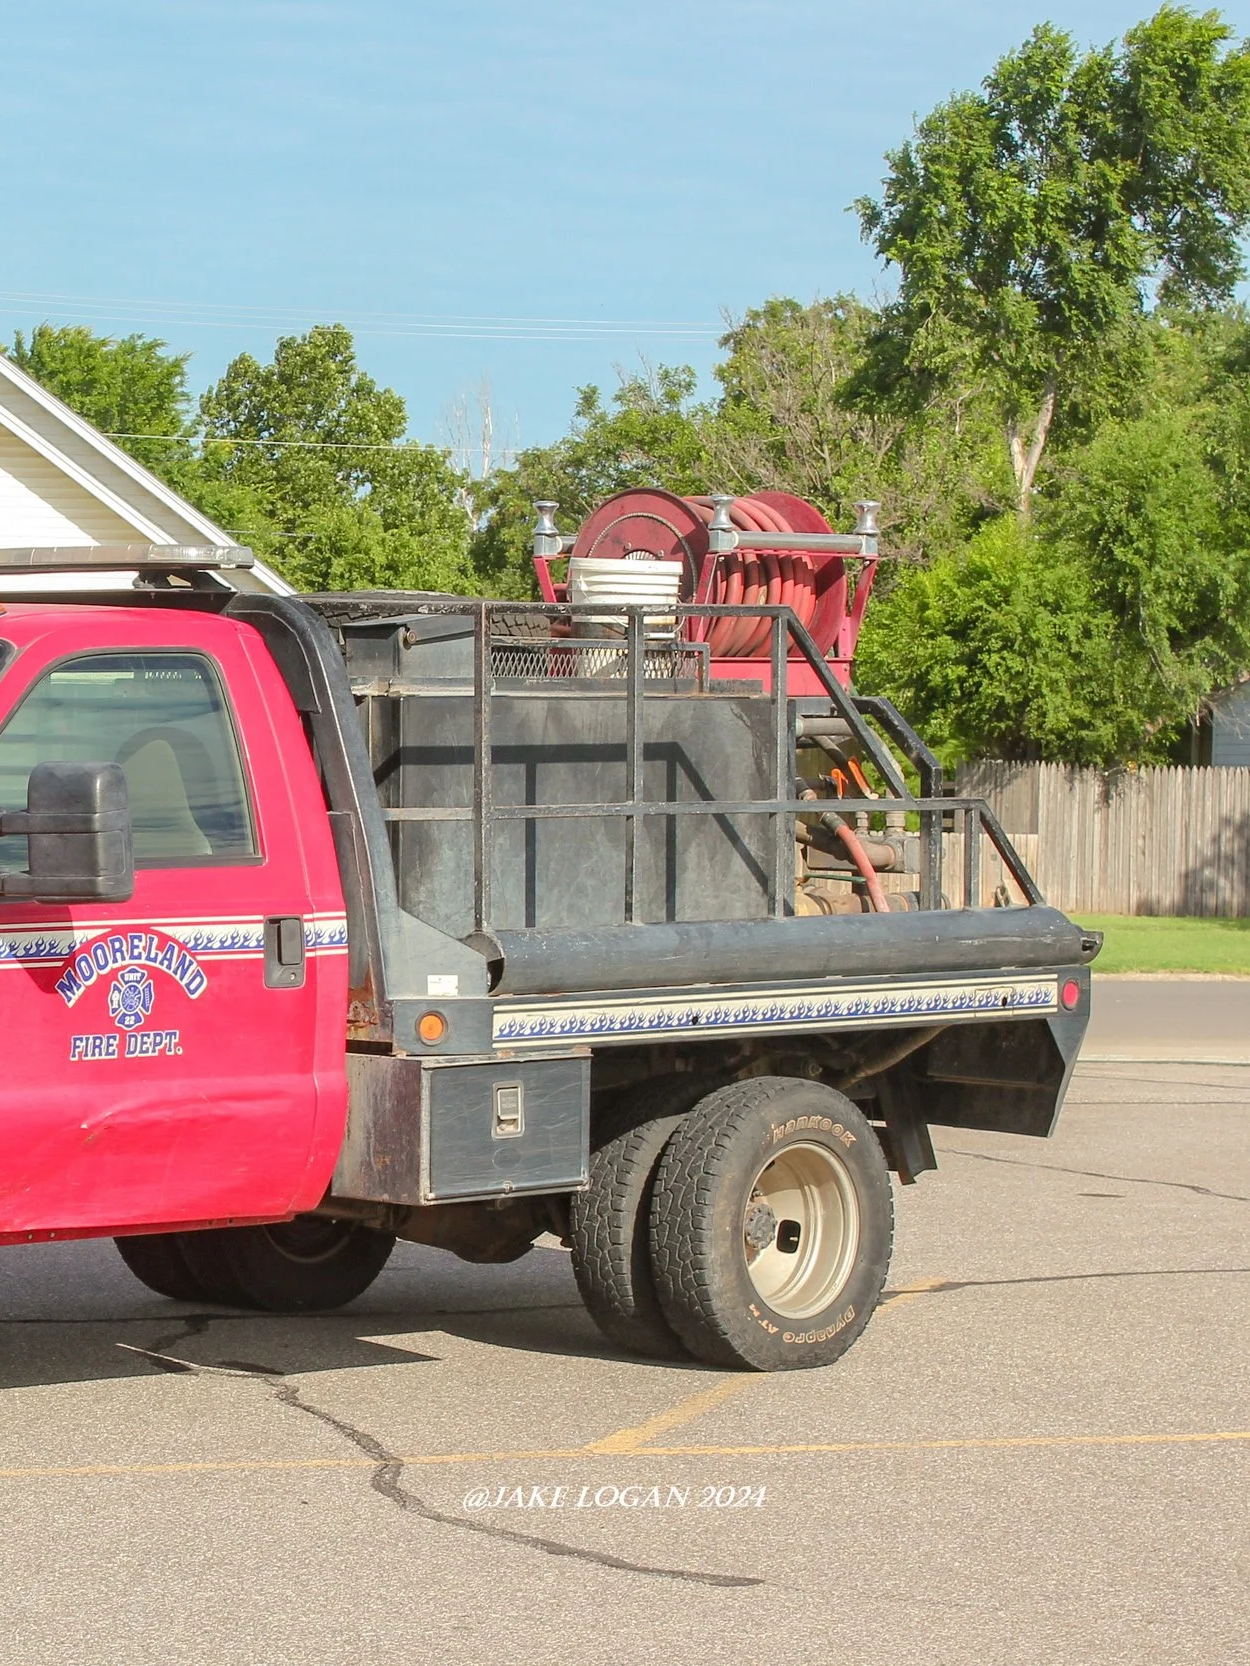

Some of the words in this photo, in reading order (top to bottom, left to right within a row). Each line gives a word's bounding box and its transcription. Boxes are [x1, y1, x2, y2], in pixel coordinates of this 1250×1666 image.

[55, 933, 208, 1008] MOORELAND
[124, 972, 142, 981] UNIT
[124, 1015, 136, 1025] 22
[70, 1034, 119, 1060] FIRE
[125, 1030, 183, 1058] DEPT.
